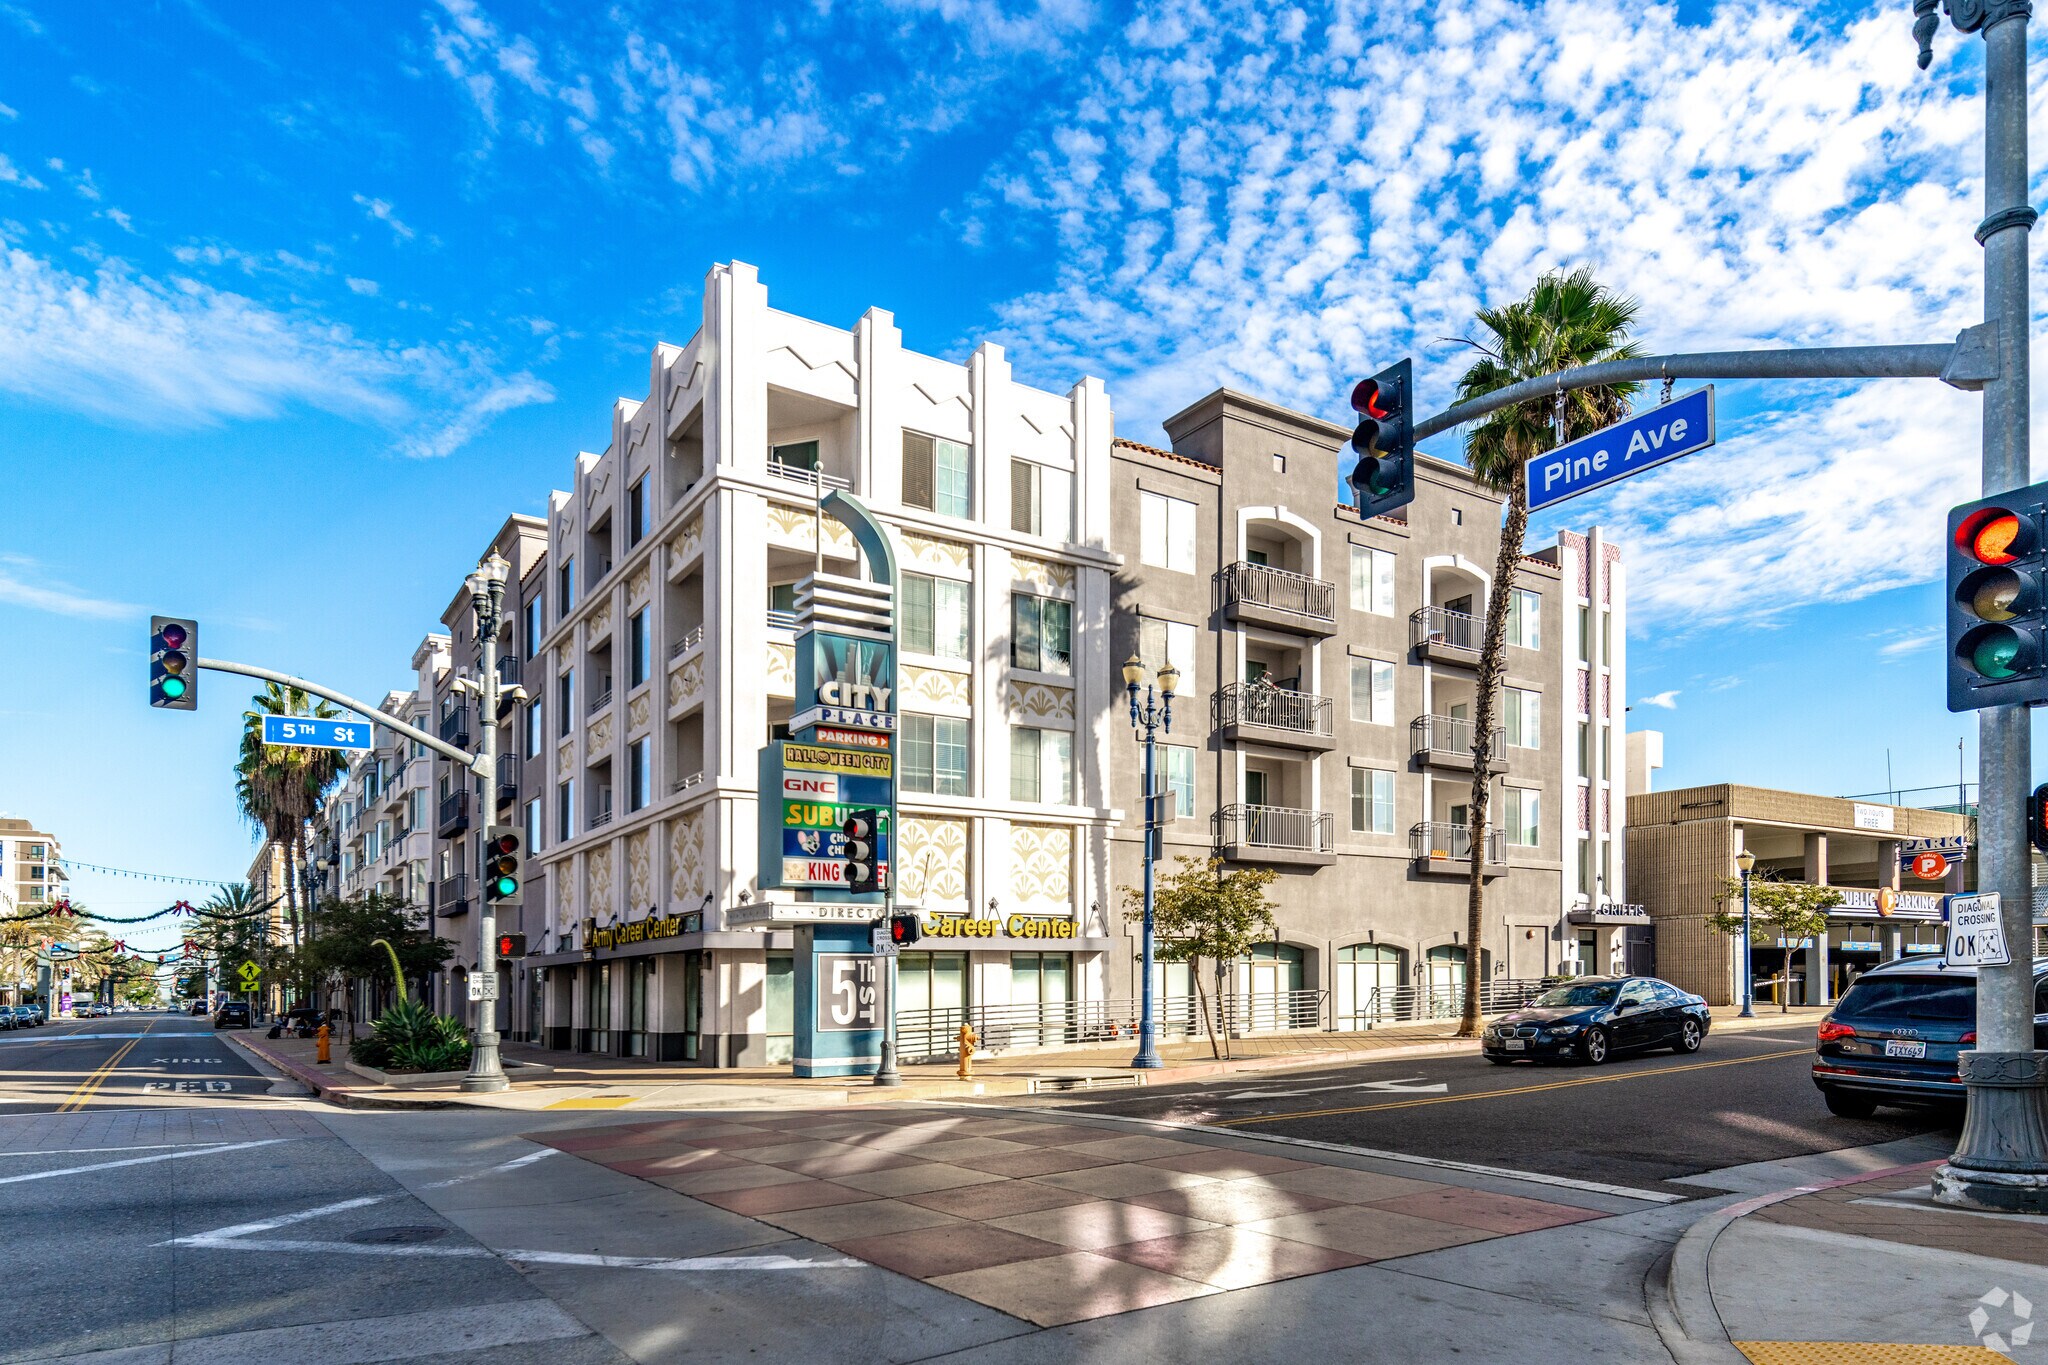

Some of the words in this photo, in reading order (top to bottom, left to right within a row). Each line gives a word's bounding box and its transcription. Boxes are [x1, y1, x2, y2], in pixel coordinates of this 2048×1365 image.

[1545, 449, 1609, 492] Pine
[1624, 418, 1688, 461] Ave
[819, 680, 892, 711] CITY
[282, 723, 316, 739] 5TH
[333, 727, 355, 742] St
[818, 730, 878, 746] PARKING
[786, 748, 861, 768] HALLOWEEN
[862, 754, 889, 770] CITY
[784, 779, 835, 793] GNC
[1864, 817, 1879, 828] FREE
[1901, 836, 1959, 851] PARK
[808, 862, 840, 881] KING
[1921, 859, 1936, 872] P
[1840, 889, 1876, 907] PUBLIC
[1893, 893, 1937, 911] PARKING
[1957, 900, 1995, 913] DIAGONAL
[1601, 903, 1645, 917] GRIFFIS
[921, 912, 1000, 937] Career
[1008, 914, 1080, 938] Center
[1957, 912, 1996, 926] CROSSING
[592, 928, 614, 950] Army
[615, 922, 644, 944] Career
[646, 916, 681, 939] Center
[875, 944, 885, 953] OK
[1954, 935, 1976, 957] OK
[472, 987, 481, 996] OK
[142, 1081, 232, 1093] PED
